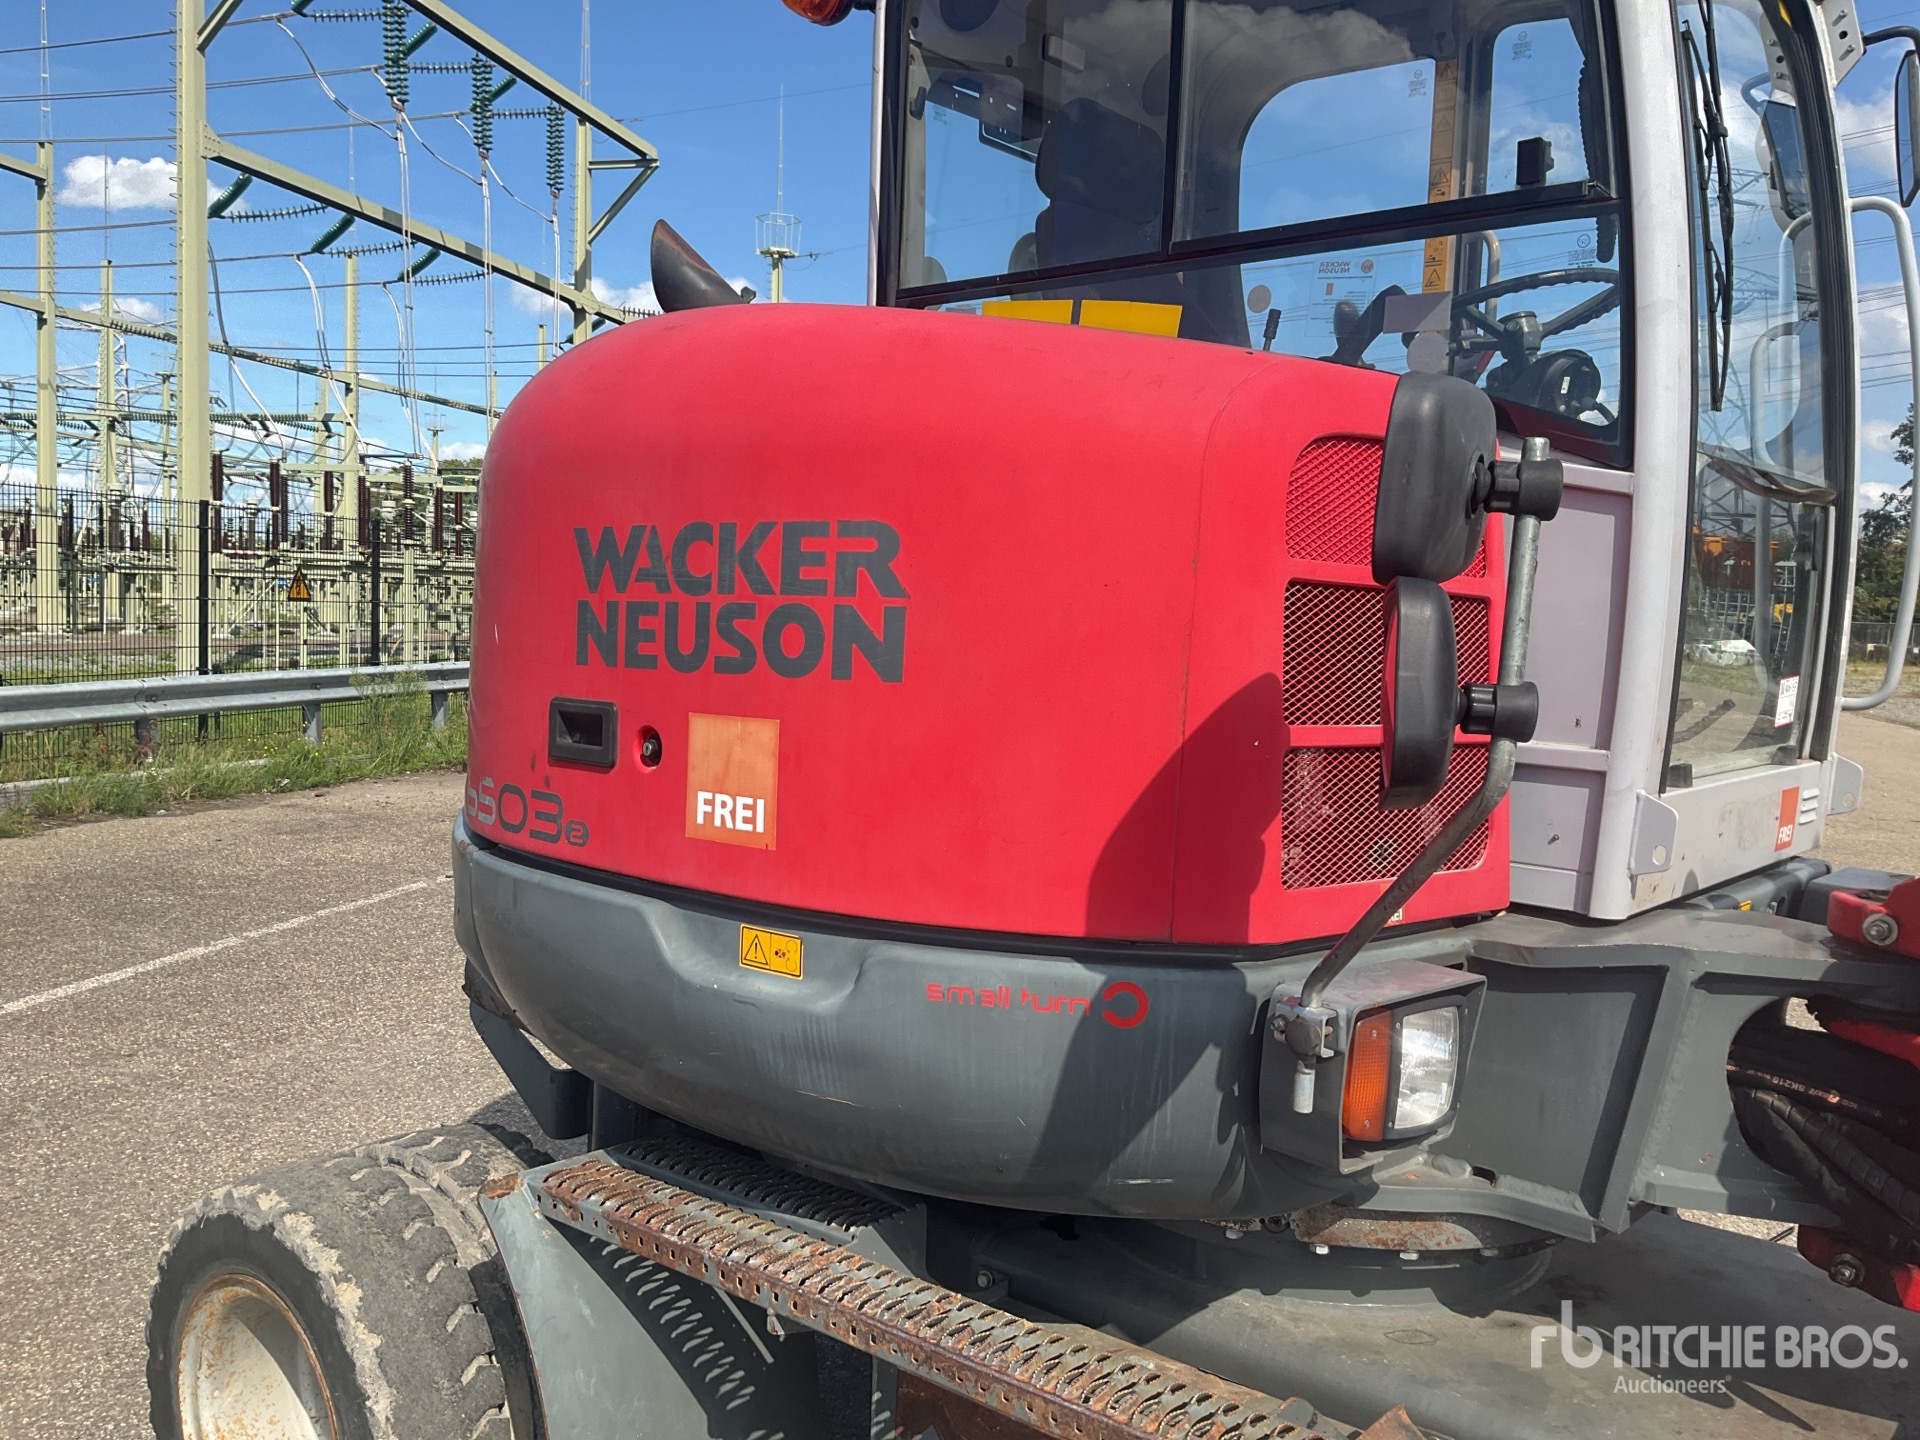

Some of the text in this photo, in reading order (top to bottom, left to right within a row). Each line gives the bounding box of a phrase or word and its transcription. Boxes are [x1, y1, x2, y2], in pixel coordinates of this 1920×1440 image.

[573, 519, 911, 598] WACKER
[576, 600, 907, 683] NEUSON
[696, 790, 765, 833] FREI
[1777, 824, 1793, 845] FREI
[925, 981, 1090, 1015] small turn
